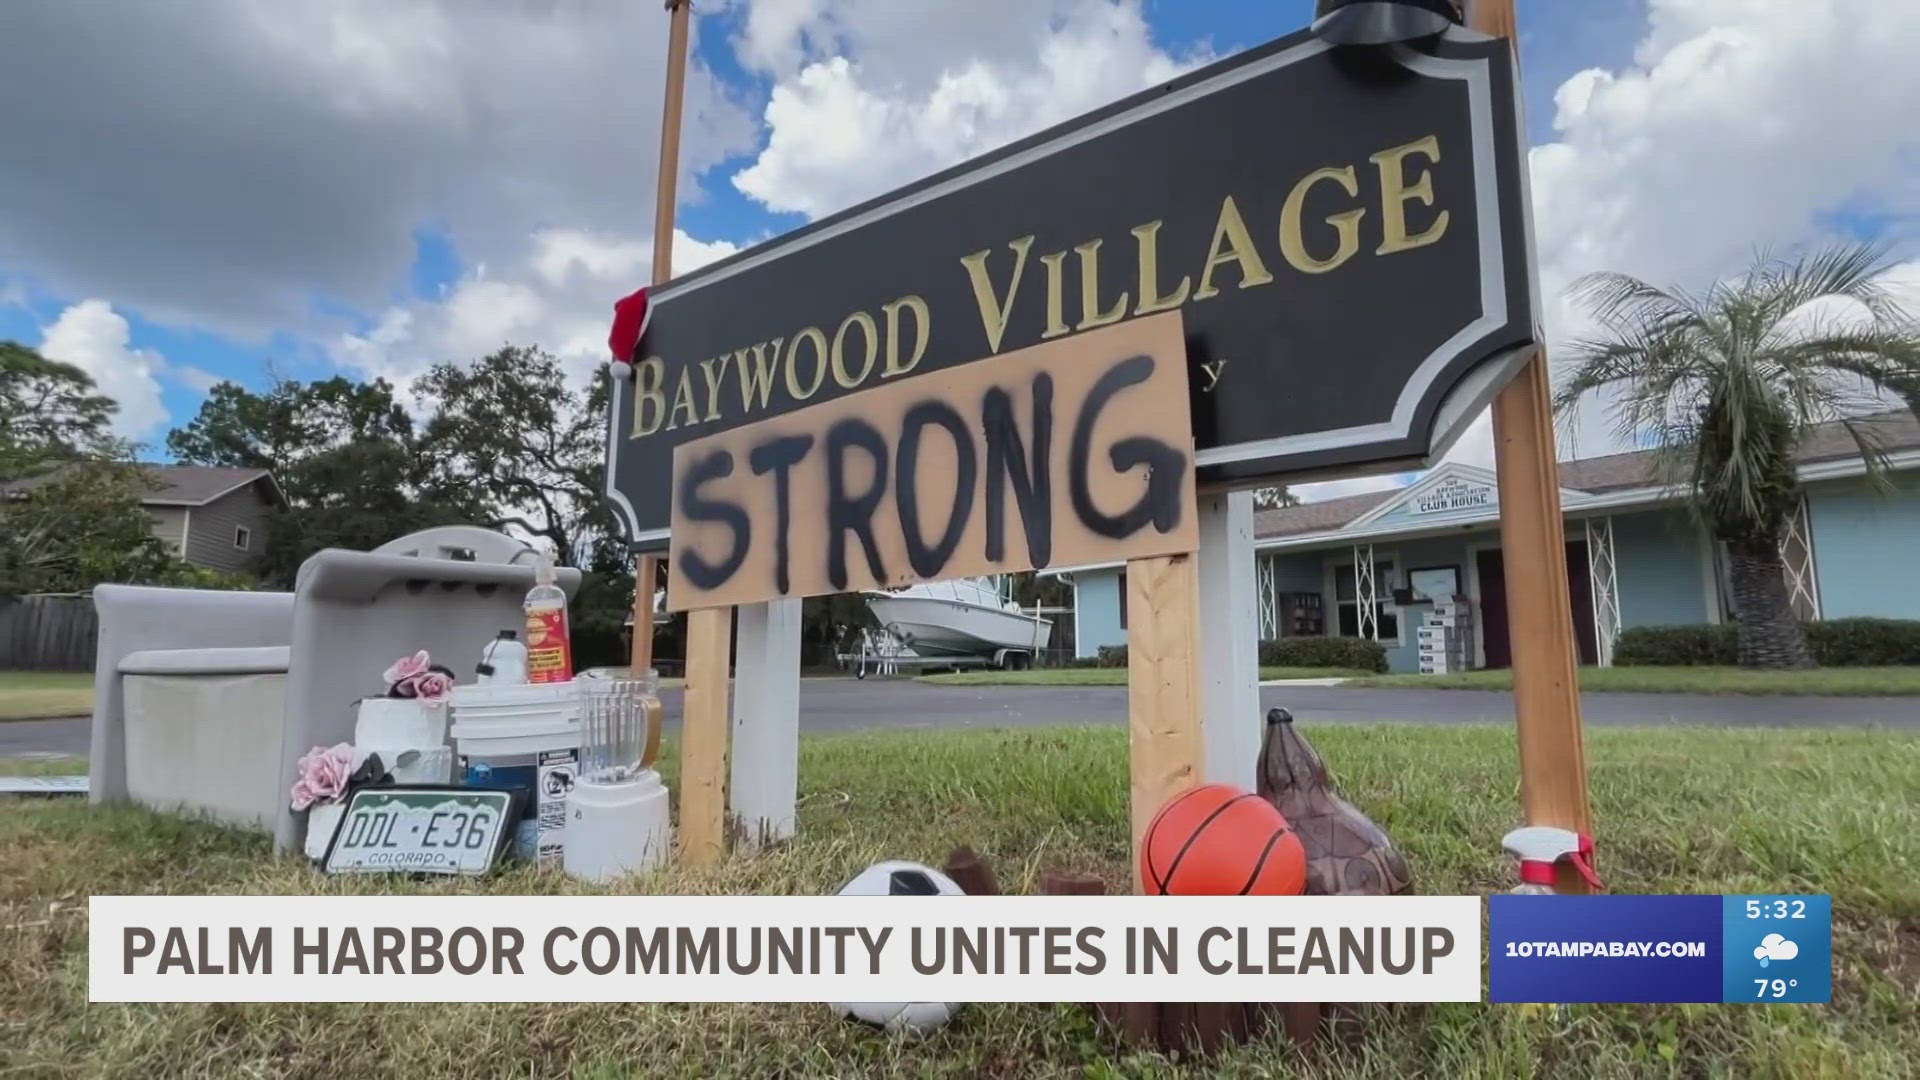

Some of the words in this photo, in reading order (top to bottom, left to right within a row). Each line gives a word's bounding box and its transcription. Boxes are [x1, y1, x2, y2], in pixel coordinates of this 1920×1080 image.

[630, 295, 931, 440] BAYWOOD
[960, 135, 1450, 355] VILLAGE
[678, 354, 1188, 596] STRONG
[1420, 501, 1448, 512] CLUB
[1451, 493, 1488, 508] HOUSE
[368, 852, 446, 864] COLORADO
